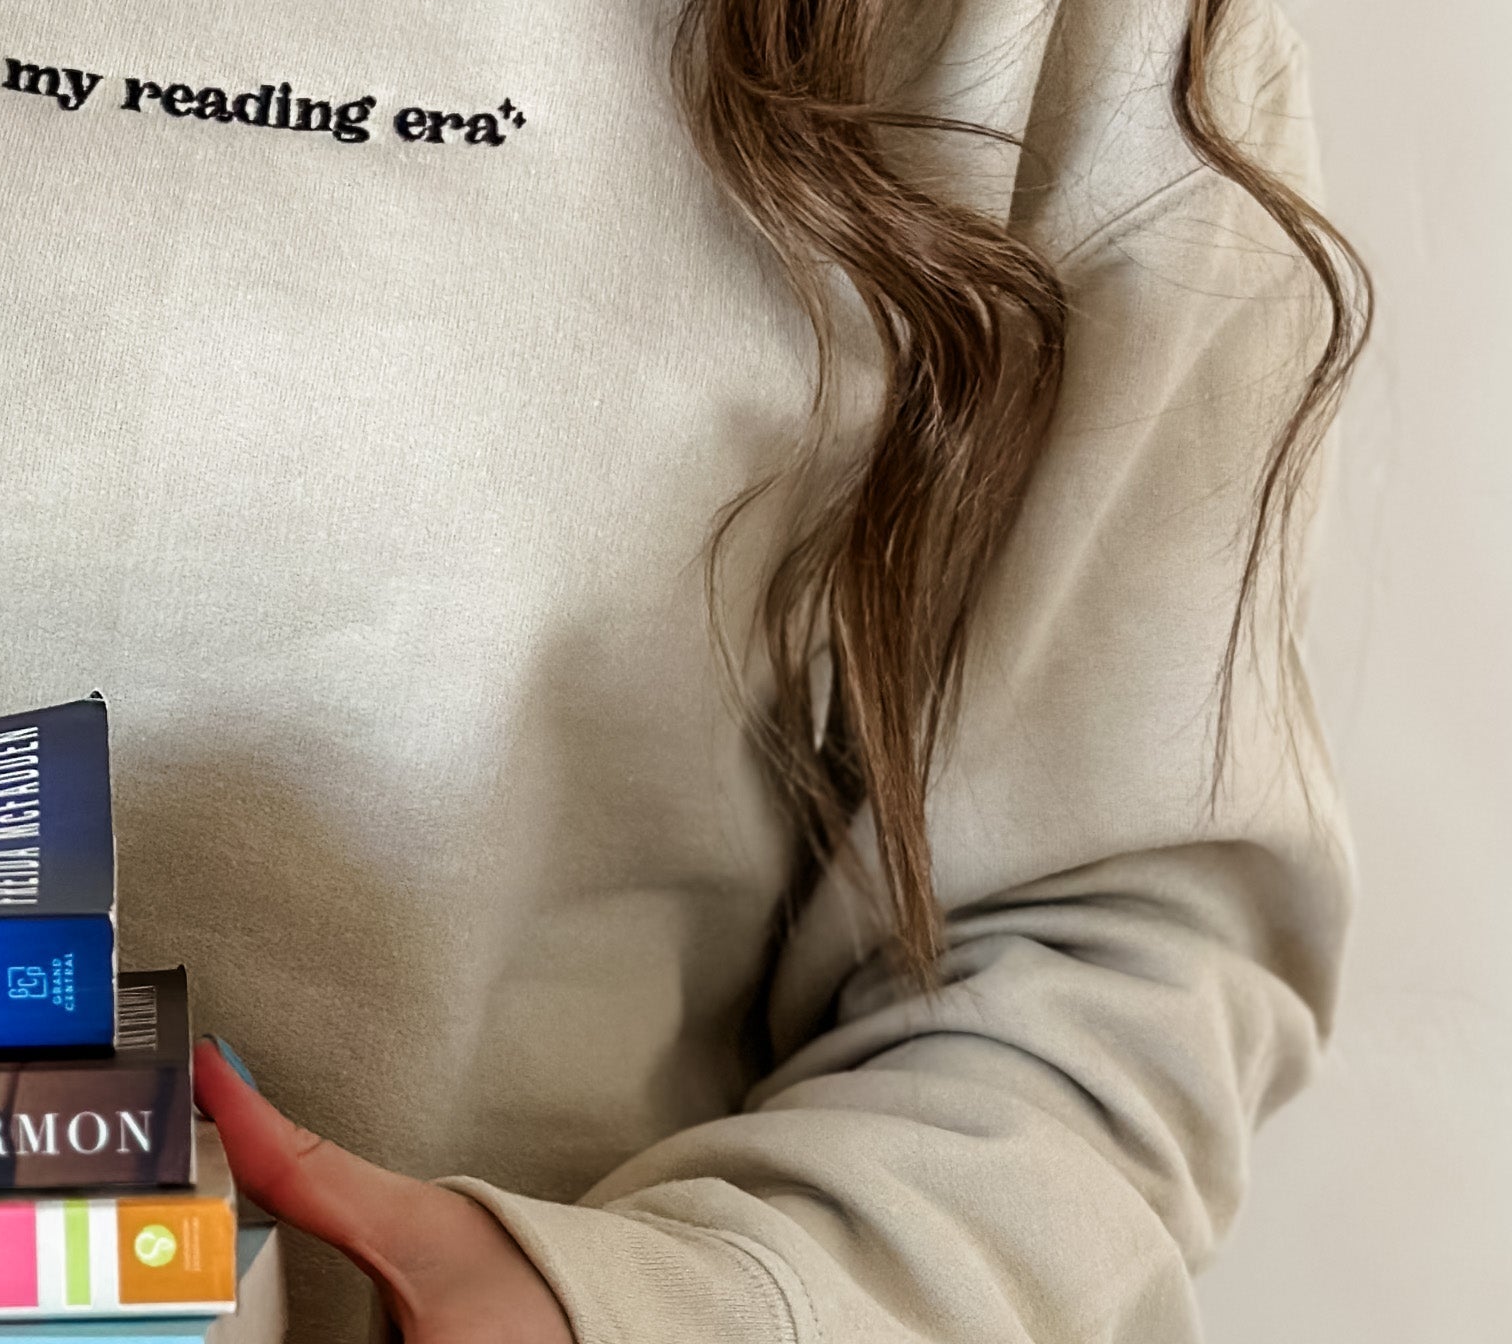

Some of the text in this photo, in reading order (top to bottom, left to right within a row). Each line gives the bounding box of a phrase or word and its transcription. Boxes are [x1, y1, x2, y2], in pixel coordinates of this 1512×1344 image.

[2, 55, 103, 110] my
[121, 75, 376, 143] reading
[393, 103, 507, 147] era
[52, 958, 62, 1005] GRAND
[64, 953, 74, 1012] CENTRAL
